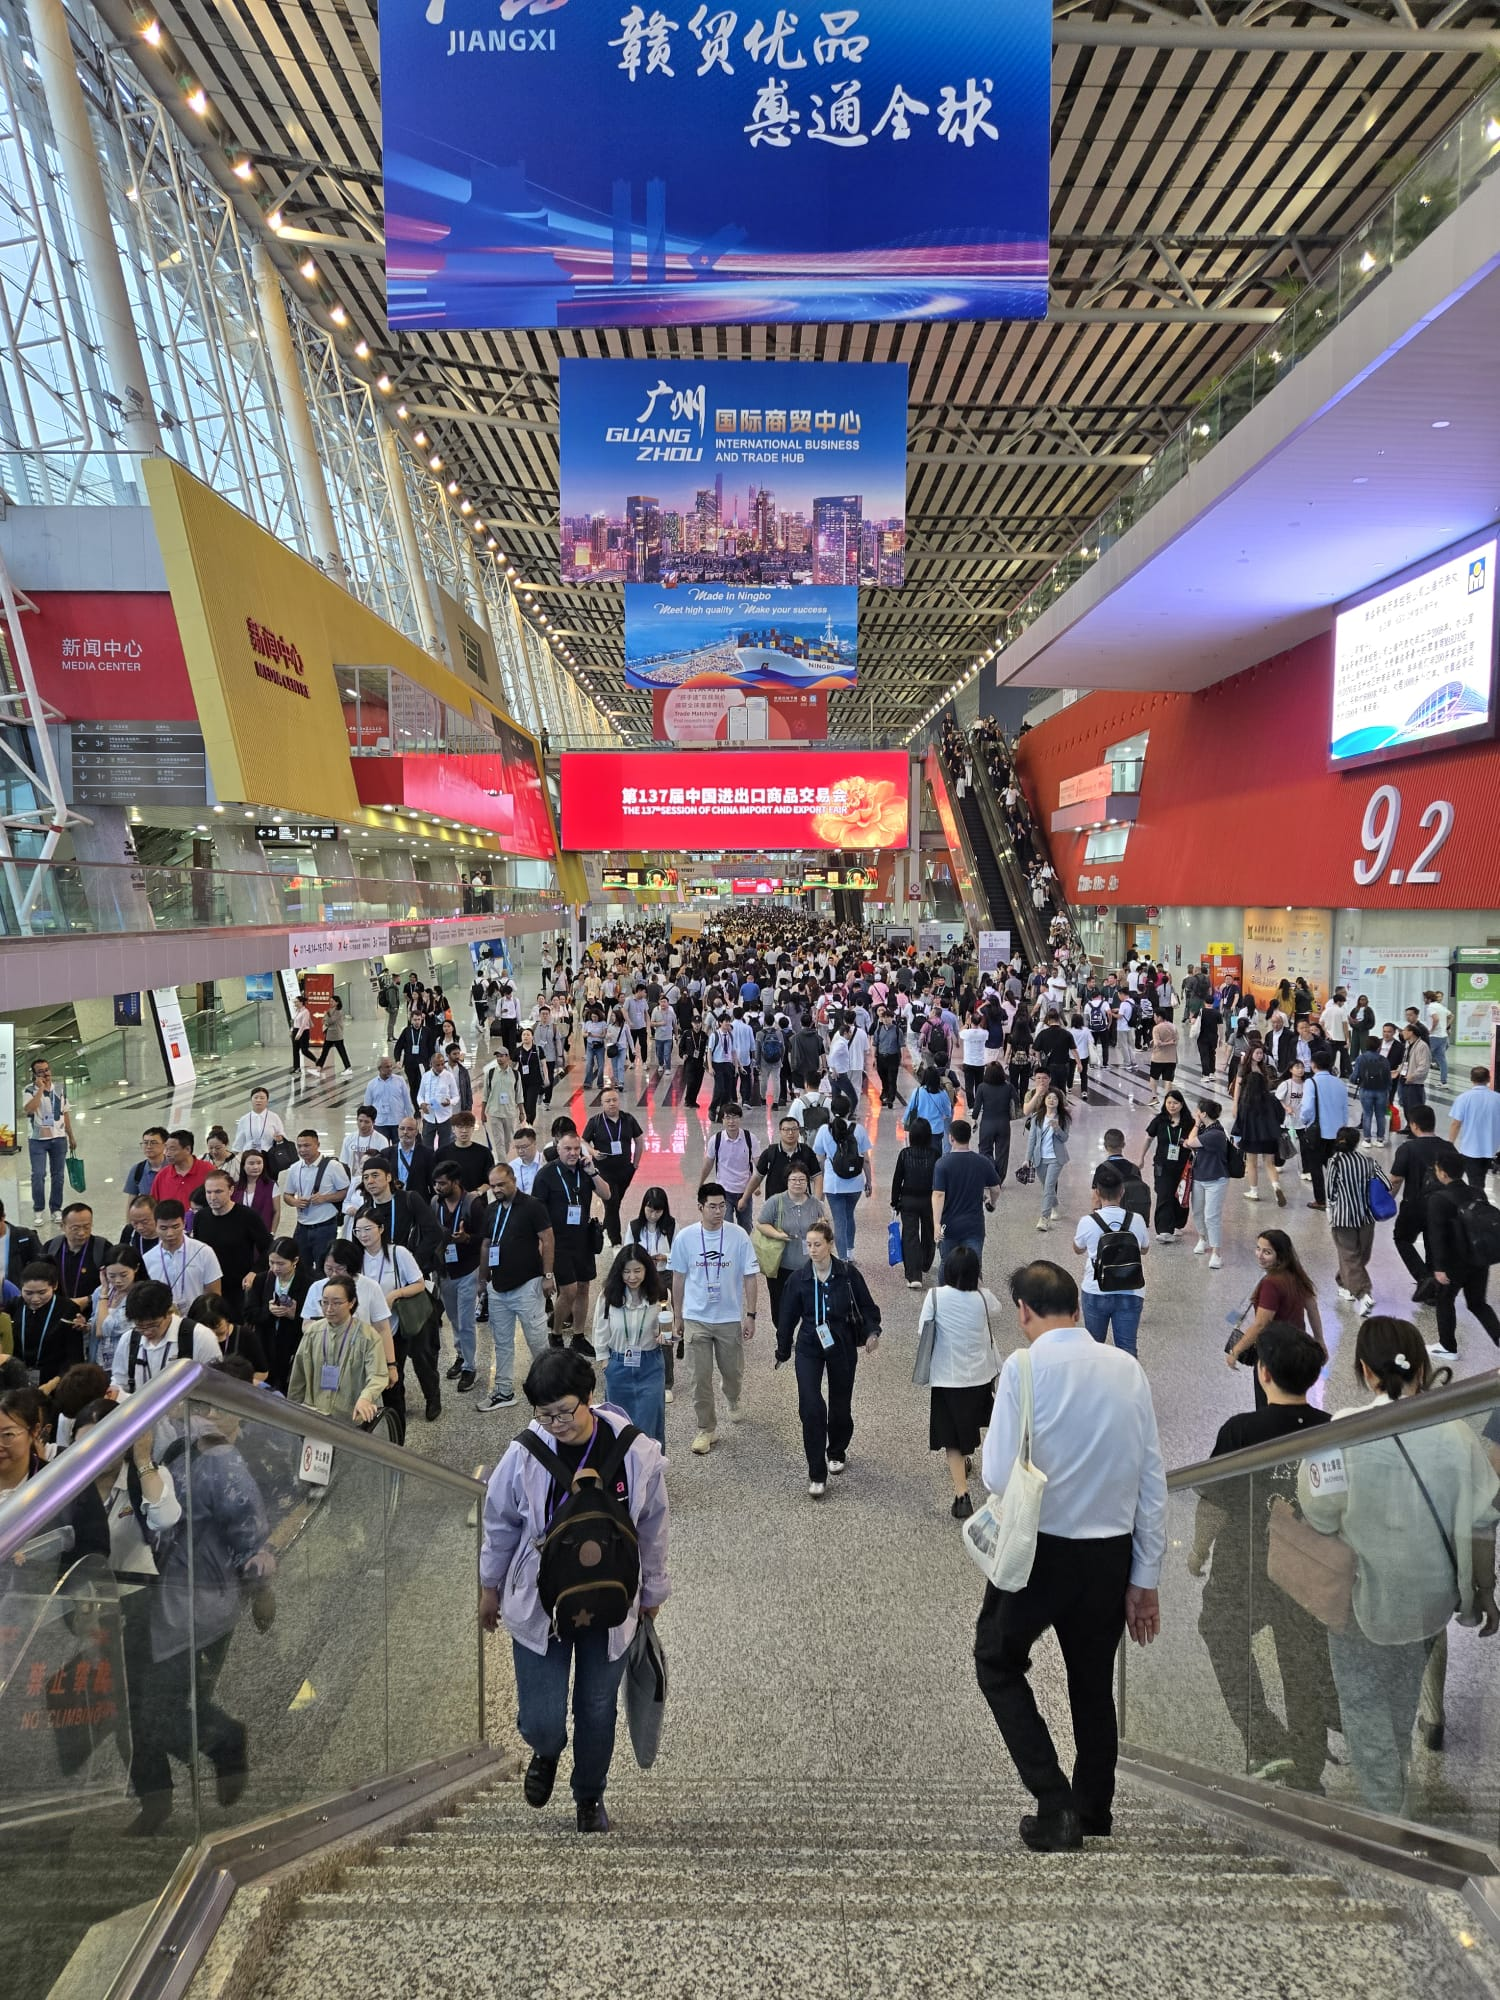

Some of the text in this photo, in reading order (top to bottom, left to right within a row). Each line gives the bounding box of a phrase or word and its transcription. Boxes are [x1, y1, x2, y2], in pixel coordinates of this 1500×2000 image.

[447, 29, 556, 56] JIANGXI
[608, 4, 870, 82] 赣贸优品
[744, 77, 999, 148] 惠通全球
[636, 380, 706, 440] 广州
[715, 408, 861, 435] 国际商贸中心
[605, 427, 692, 443] GUANG
[715, 438, 860, 450] INTERNATIONAL BUSINESS
[636, 447, 703, 462] ZHOU
[715, 453, 805, 463] AND TRADE HUB
[688, 588, 723, 601] Made
[737, 591, 772, 602] Ningbo
[653, 603, 683, 615] Meet
[685, 606, 703, 615] high
[705, 606, 733, 616] quality
[739, 603, 770, 614] Make
[772, 607, 791, 615] your
[62, 638, 143, 658] 新闻中心
[246, 617, 304, 676] 新闻中心
[62, 661, 141, 671] MEDIA CENTER
[809, 662, 835, 670] NINGBO
[622, 787, 847, 804] 第137届中国进出口商品交易会
[622, 806, 640, 815] THE
[661, 806, 698, 815] SESSION
[698, 806, 711, 815] OF
[711, 806, 738, 815] CHINA
[739, 806, 772, 815] IMPORT
[773, 806, 792, 815] AND
[793, 806, 826, 815] EXPORT
[829, 806, 847, 814] FAIR
[1354, 784, 1455, 885] 9.2
[20, 1711, 40, 1729] NO
